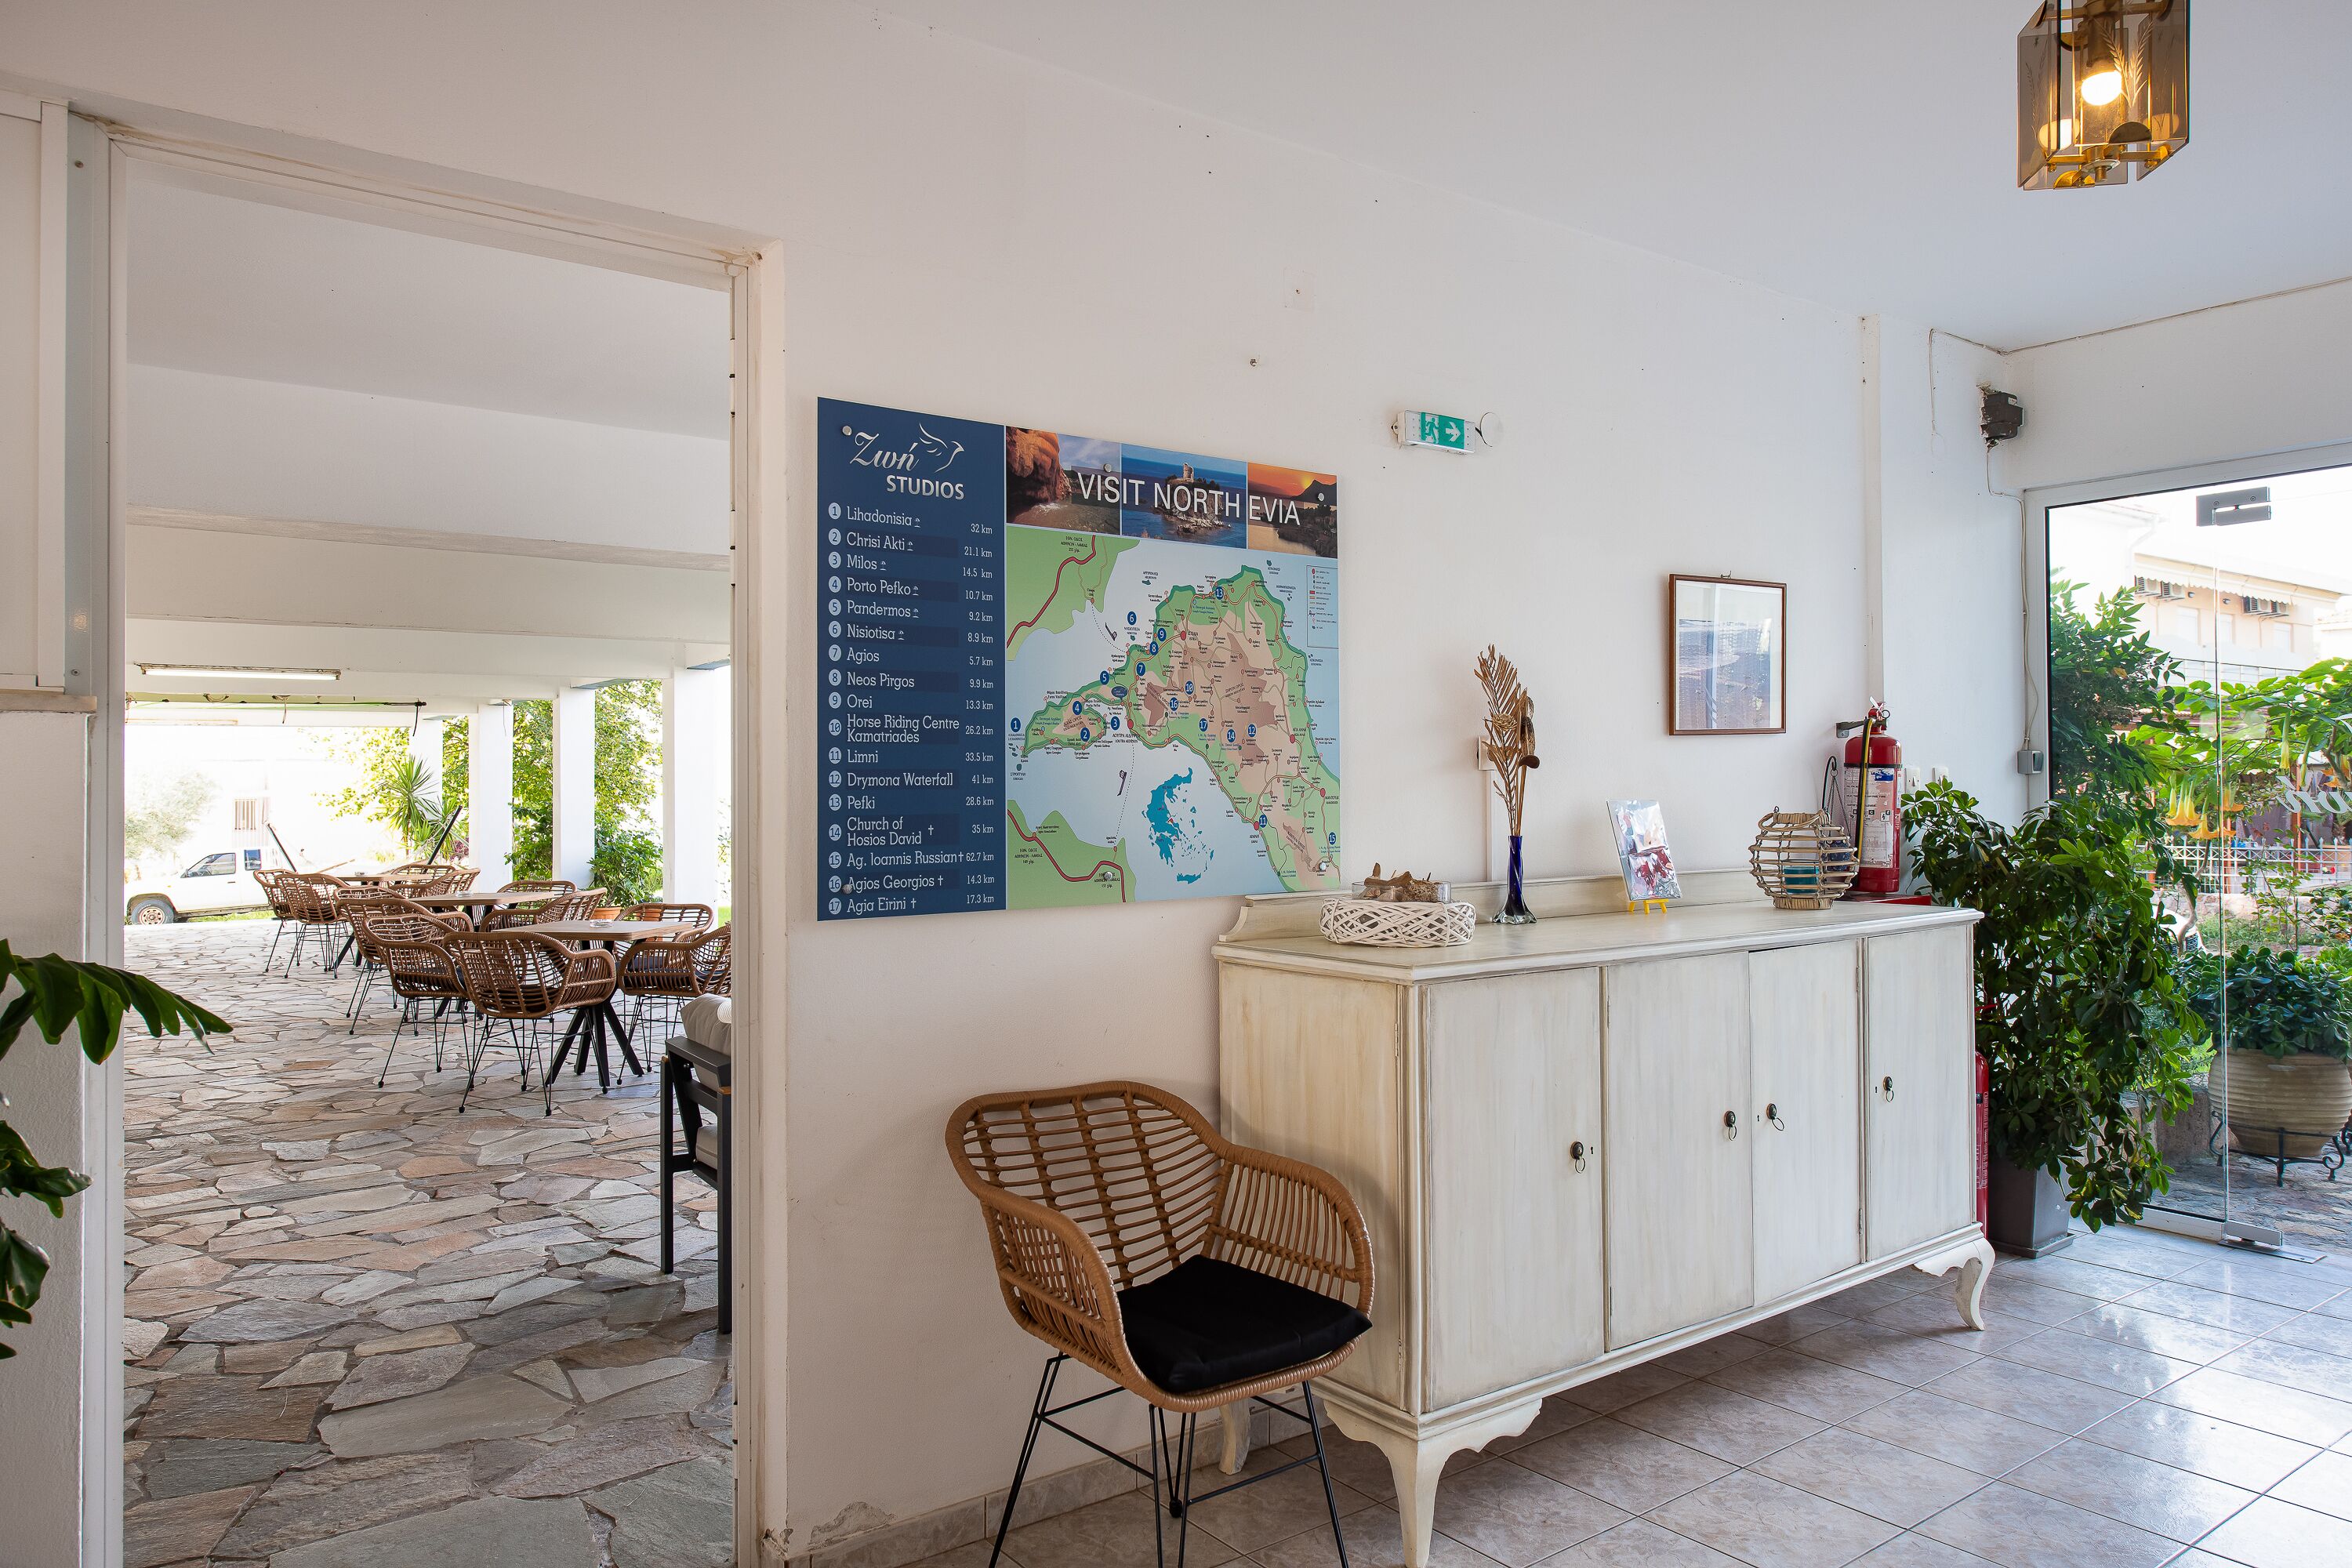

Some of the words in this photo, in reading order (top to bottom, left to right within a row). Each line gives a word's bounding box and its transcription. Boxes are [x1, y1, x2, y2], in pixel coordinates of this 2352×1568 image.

[887, 474, 964, 500] STUDIOS
[1078, 473, 1145, 505] VISIT
[1154, 483, 1240, 517] NORTH
[1250, 495, 1300, 525] EVIA
[832, 506, 837, 515] 1
[847, 506, 912, 525] Lihadonisia
[971, 524, 979, 532] 32
[982, 524, 992, 534] km
[832, 532, 838, 541] 2
[848, 532, 880, 547] Chrisi
[884, 535, 904, 550] Akti
[965, 546, 978, 556] 21.1
[982, 548, 992, 557] km
[832, 556, 837, 564] 3
[848, 554, 877, 569] Milos
[964, 568, 977, 576] 14.5
[982, 568, 992, 578] km
[832, 579, 838, 589] 4
[848, 577, 876, 592] Porto
[880, 580, 910, 594] Pefko
[966, 590, 979, 599] 10.7
[982, 591, 993, 601] km
[832, 603, 838, 612] 5
[848, 600, 910, 617] Pandermos
[969, 612, 979, 620] 9.2
[982, 612, 993, 621] km
[832, 625, 838, 633] 6
[848, 624, 895, 639] Nisiotisa
[968, 633, 978, 642] 8.9
[982, 633, 993, 643] km
[832, 648, 838, 657] 7
[847, 648, 879, 664] Agios
[970, 656, 979, 665] 5.7
[982, 657, 993, 666] km
[832, 673, 838, 682] 8
[848, 672, 876, 685] Neos
[880, 673, 914, 690] Pirgos
[970, 679, 980, 688] 9.9
[832, 695, 838, 705] 9
[848, 695, 872, 708] Orei
[967, 700, 980, 709] 13.3
[830, 723, 840, 731] 10
[848, 714, 880, 729] Horse
[884, 715, 919, 733] Riding
[923, 716, 959, 728] Centre
[982, 726, 993, 735] km
[848, 728, 919, 742] Kamatriades
[830, 751, 840, 760] 11
[848, 750, 877, 762] Limni
[982, 753, 993, 761] km
[830, 775, 840, 783] 12
[848, 773, 900, 789] Drymona
[903, 773, 953, 786] Waterfall
[972, 775, 979, 783] 41
[982, 775, 993, 783] km
[830, 798, 840, 807] 13
[848, 796, 874, 809] Pefki
[966, 797, 980, 805] 28.6
[983, 797, 993, 805] km
[830, 828, 840, 837] 14
[847, 817, 889, 831] Church
[892, 816, 902, 829] of
[983, 824, 993, 833] km
[848, 833, 885, 846] Hosios
[890, 831, 921, 844] David
[830, 855, 840, 865] 15
[847, 853, 866, 869] Ag.
[915, 851, 956, 863] Russian
[967, 852, 981, 861] 62.7
[830, 880, 840, 888] 16
[848, 877, 880, 893] Agios
[884, 875, 934, 890] Georgios
[967, 875, 981, 884] 14.3
[984, 874, 994, 883] km
[830, 902, 840, 911] 17
[847, 899, 874, 915] Agia
[878, 898, 906, 910] Eirini
[967, 895, 981, 903] 17.3
[983, 894, 993, 902] km
